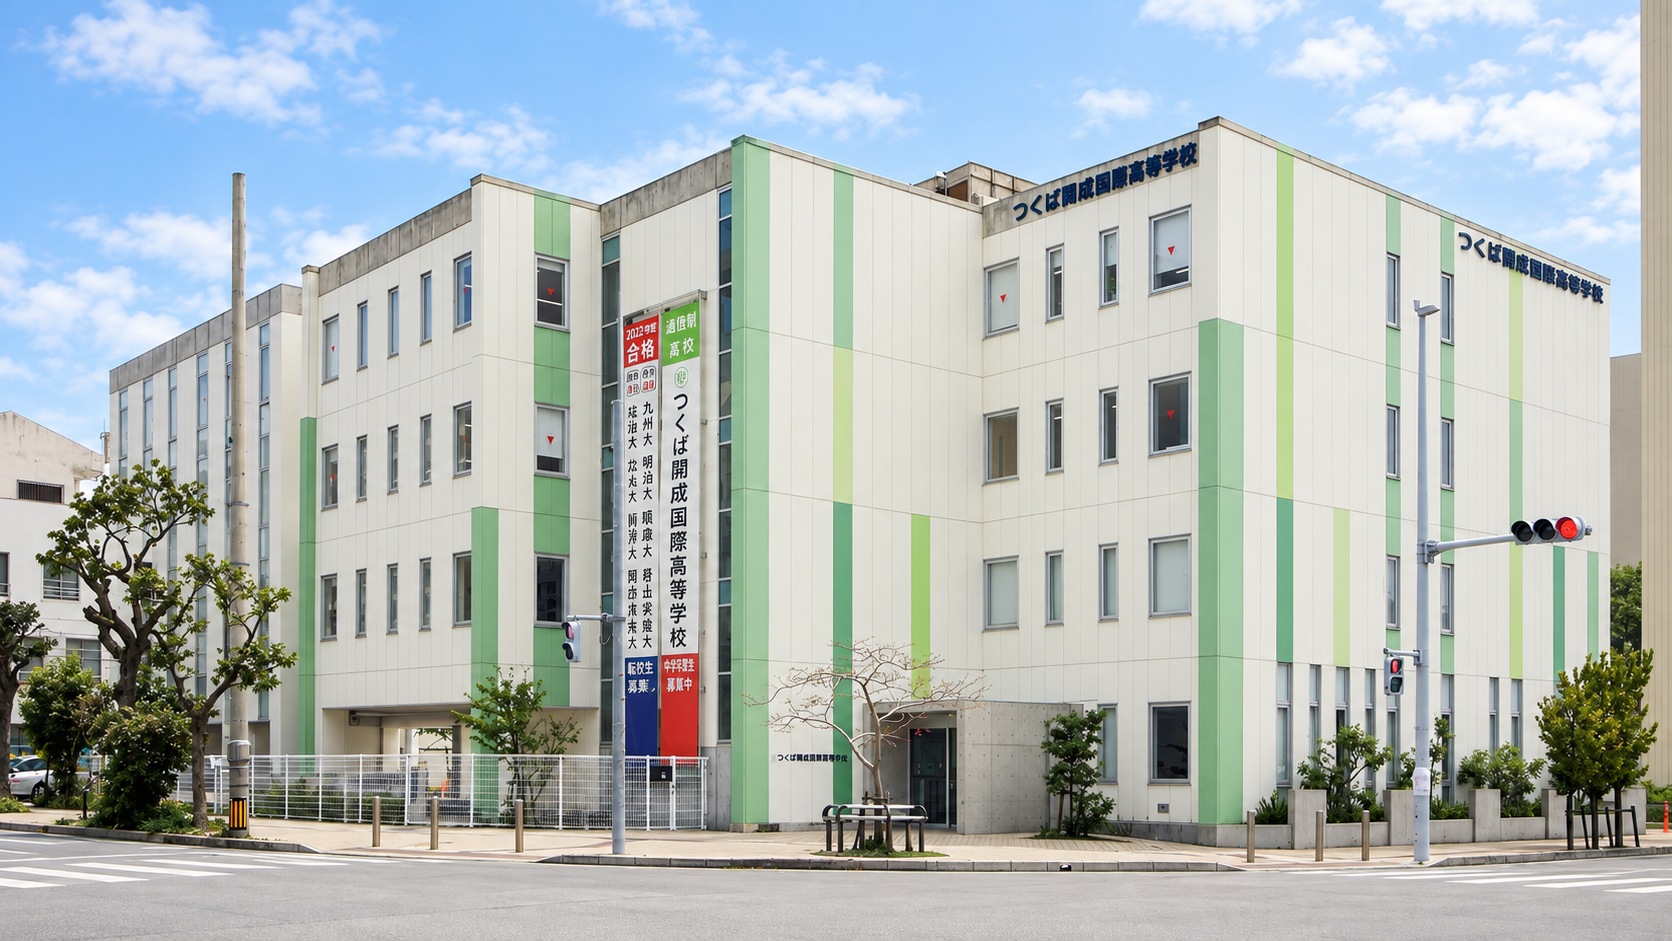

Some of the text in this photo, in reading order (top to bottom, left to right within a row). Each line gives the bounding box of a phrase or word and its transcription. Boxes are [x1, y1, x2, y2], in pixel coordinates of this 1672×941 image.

[1013, 142, 1197, 222] つくば開成国際高等学校
[1458, 231, 1604, 304] つくば開成国際高等学校
[627, 339, 654, 364] 合格
[669, 393, 689, 648] つくば開成国際高等学校
